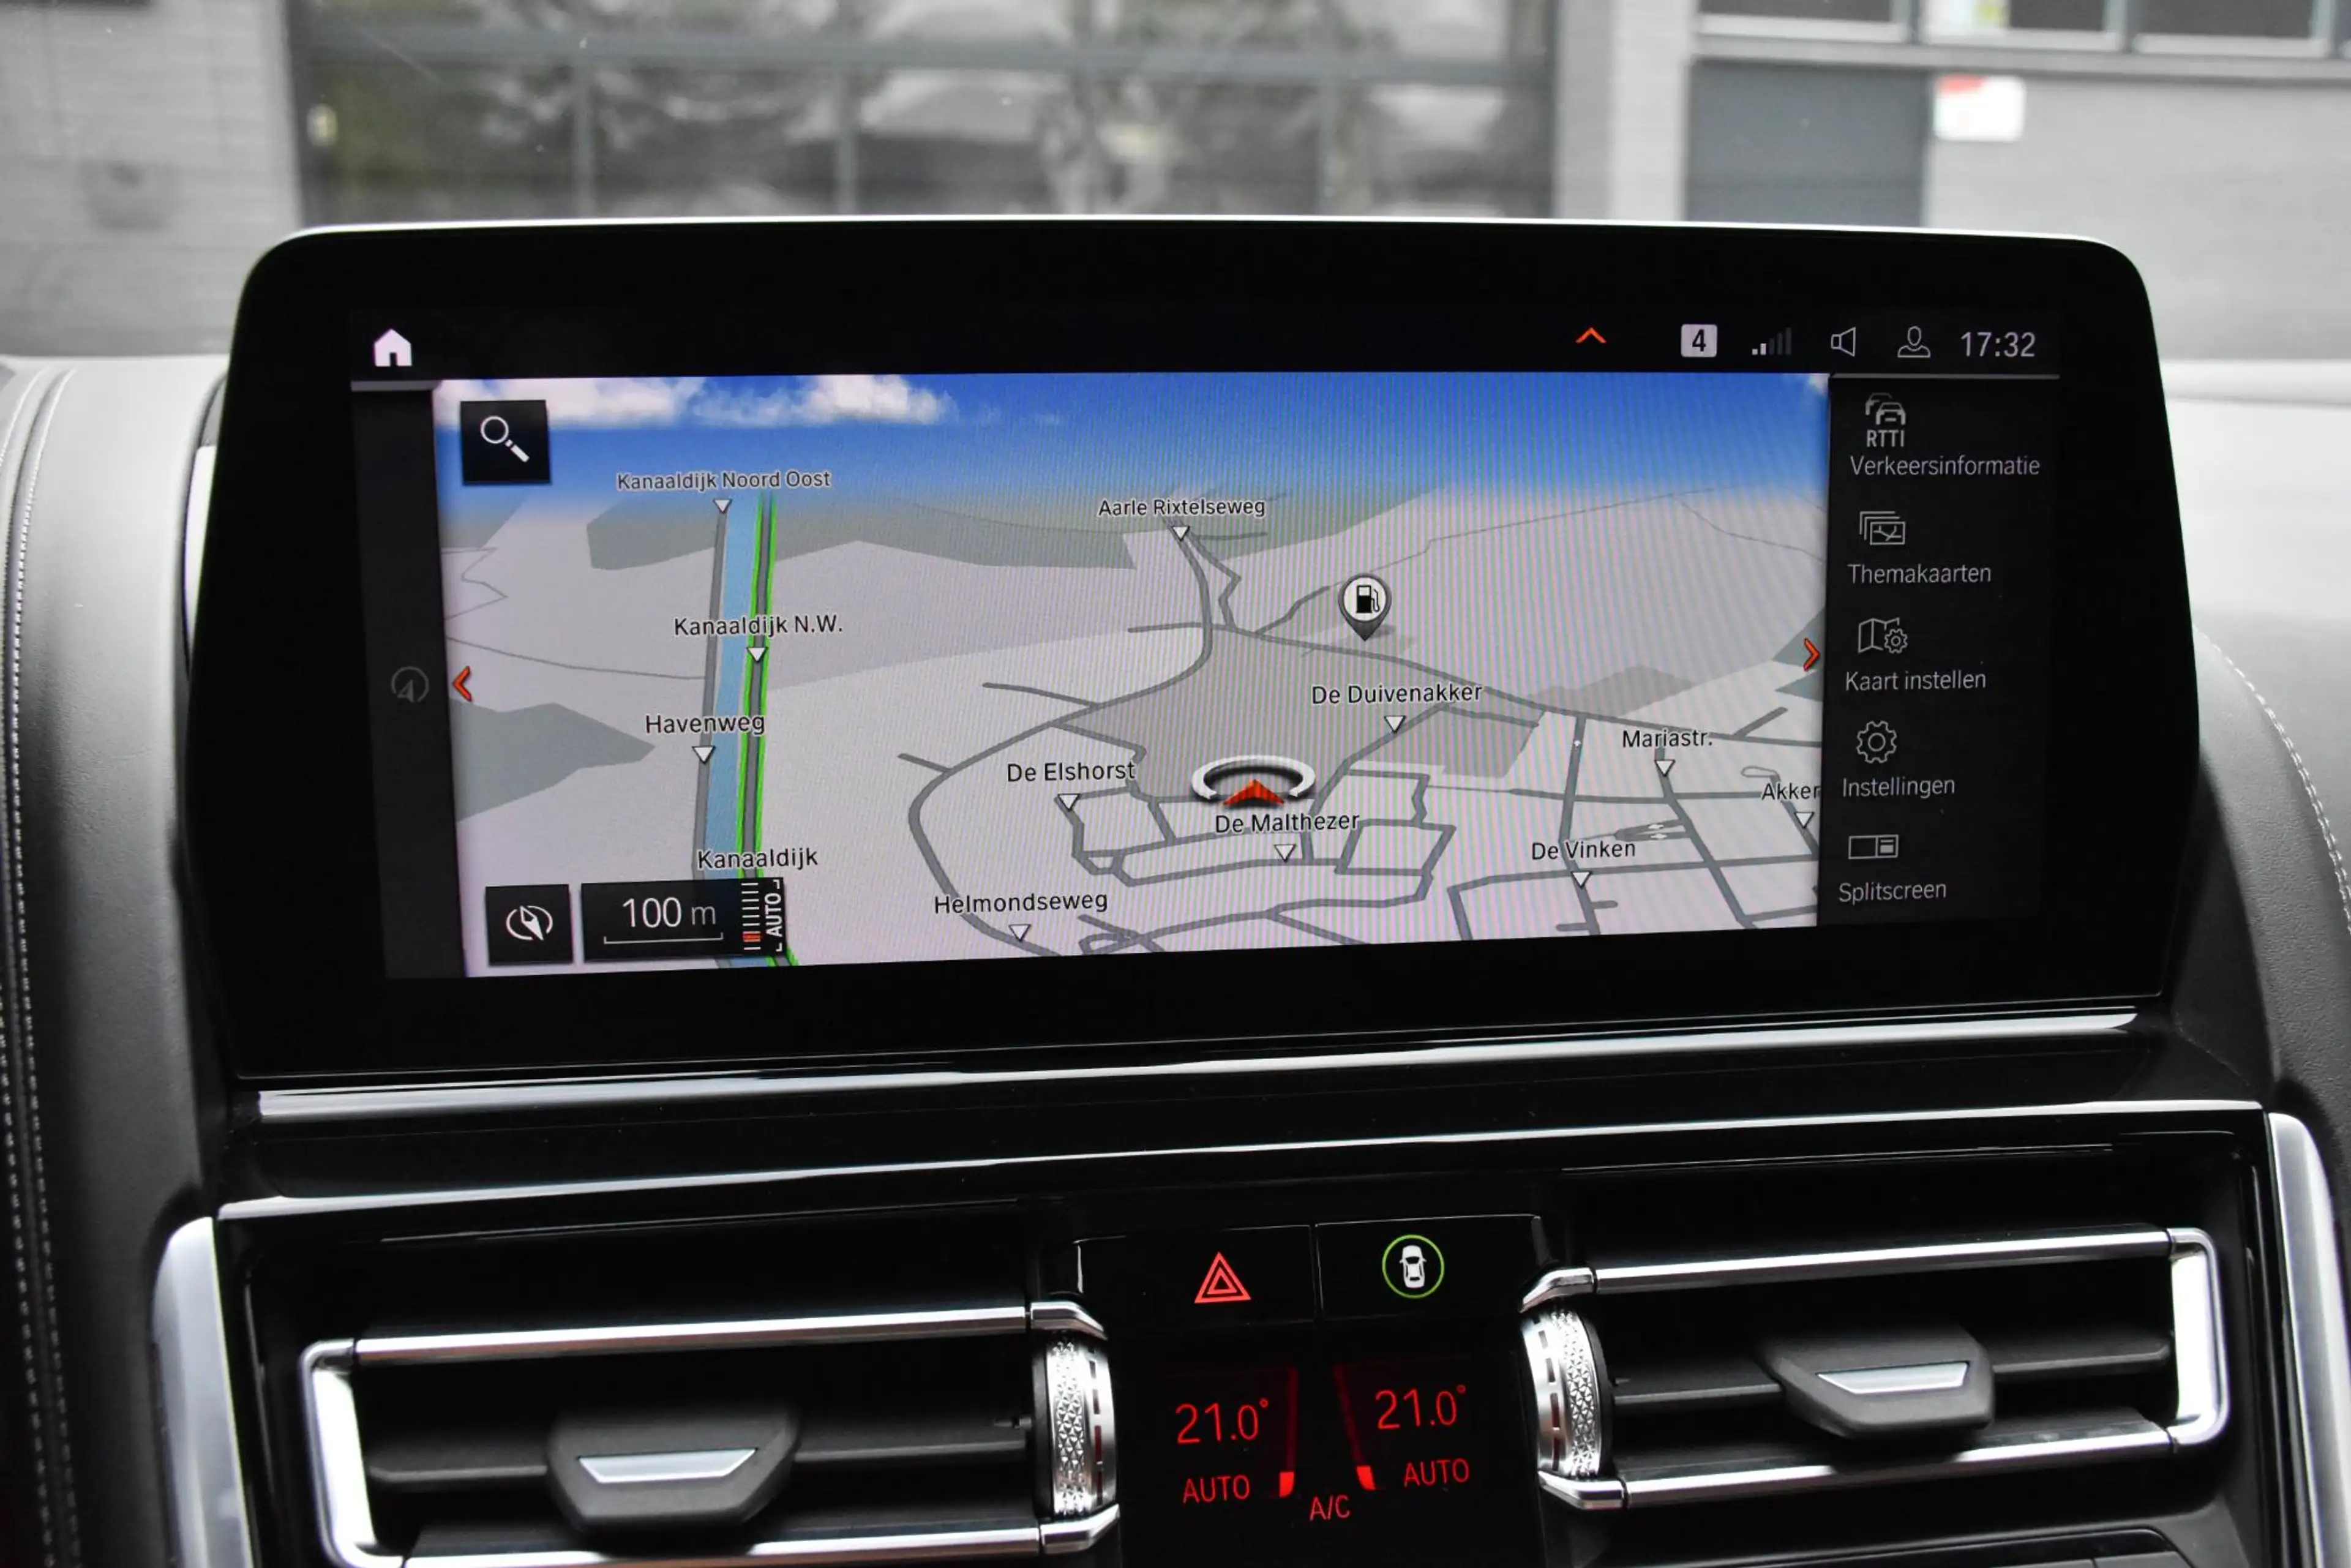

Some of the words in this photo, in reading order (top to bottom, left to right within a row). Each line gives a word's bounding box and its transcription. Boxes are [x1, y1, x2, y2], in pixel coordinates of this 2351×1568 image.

[1692, 329, 1706, 351] 4
[1960, 331, 2036, 357] 17:32
[1866, 429, 1905, 448] RTTI
[1850, 455, 2041, 476] Verkeersinformatie
[617, 472, 716, 491] Kanaaldijk
[722, 470, 780, 488] Noord
[786, 470, 831, 487] Oost
[1099, 499, 1147, 517] Aarle
[1153, 498, 1265, 518] Rixtelseweg
[1848, 563, 1992, 584] Themakaarten
[674, 616, 787, 638] Kanaaldijk
[794, 615, 843, 634] N.W.
[1846, 671, 1898, 691] Kaart
[1905, 670, 1987, 689] instellen
[1312, 686, 1340, 703] De
[1348, 684, 1482, 703] Duivenakker
[645, 715, 765, 735] Havenweg
[1622, 729, 1713, 748] Mariastr.
[1007, 763, 1037, 782] De
[1044, 761, 1136, 781] Elshorst
[1842, 776, 1955, 799] Instellingen
[1215, 815, 1244, 833] De
[1251, 812, 1360, 832] Malthezer
[698, 847, 818, 870] Kanaaldijk
[1532, 842, 1559, 859] De
[1565, 840, 1636, 858] Vinken
[934, 892, 1109, 915] Helmondseweg
[1839, 881, 1947, 905] Splitscreen
[623, 896, 682, 928] 100
[691, 906, 716, 925] m
[764, 892, 783, 937] AUTO
[1403, 1458, 1470, 1488] AUTO
[1182, 1474, 1250, 1504] AUTO
[1309, 1495, 1351, 1521] A/C
